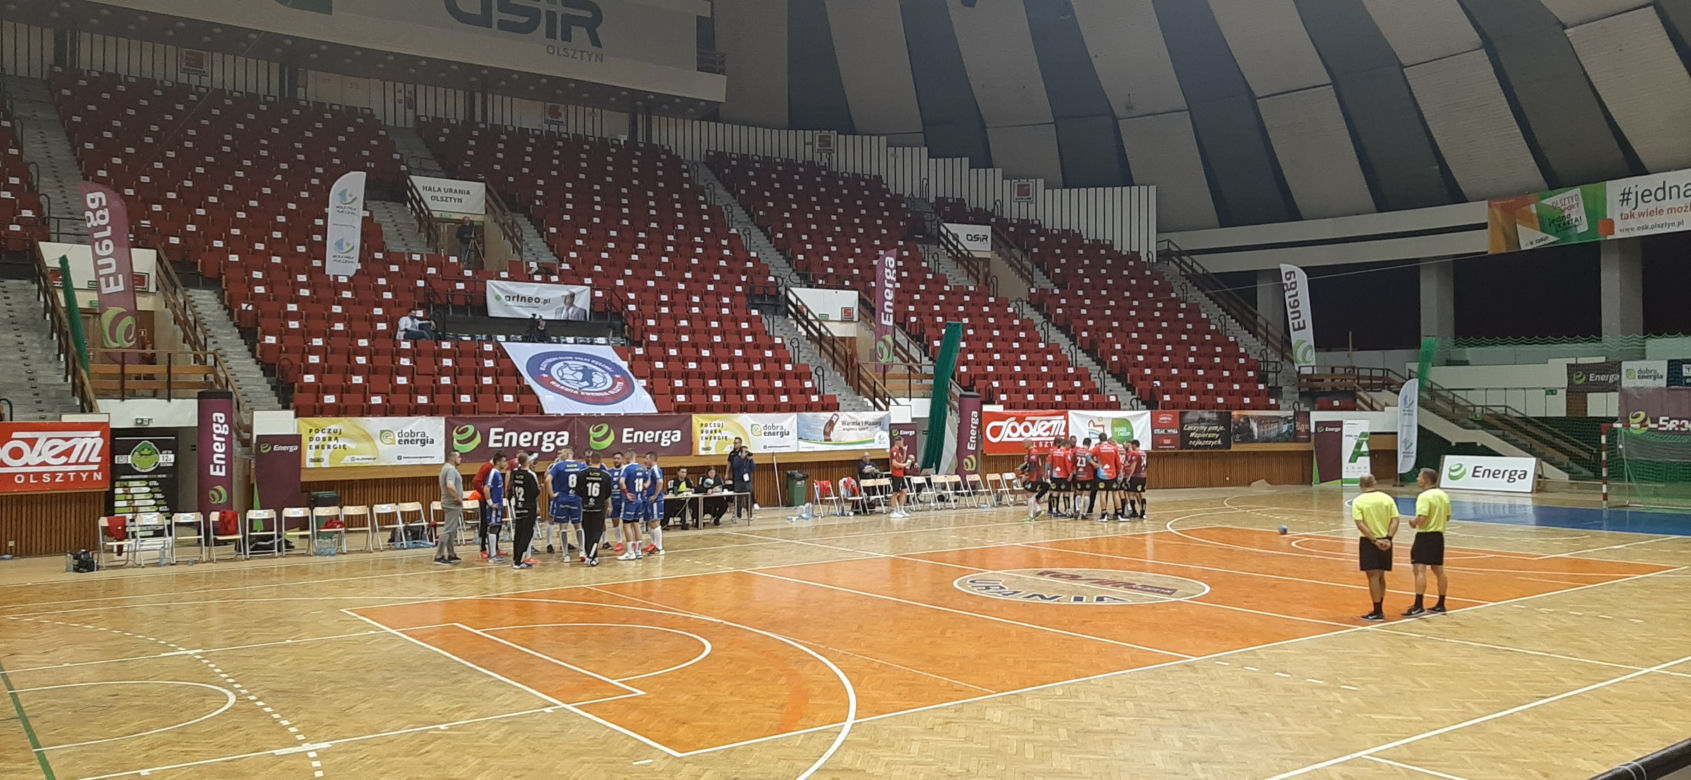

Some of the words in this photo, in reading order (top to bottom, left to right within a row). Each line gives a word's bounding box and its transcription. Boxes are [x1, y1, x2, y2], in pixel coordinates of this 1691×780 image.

[545, 44, 604, 64] OLSZTYN
[422, 184, 443, 193] HALA
[443, 187, 471, 196] URANIA
[430, 195, 463, 204] OLSZTYN
[1619, 210, 1635, 221] tak
[1637, 205, 1665, 219] wiele
[881, 255, 897, 326] Energa
[504, 293, 551, 305] artneo.pl
[1588, 372, 1620, 384] Energa
[308, 428, 343, 436] POCZUJ
[397, 428, 426, 439] dobra
[762, 423, 784, 431] dobra
[967, 410, 979, 451] Energa
[488, 427, 570, 452] Energa
[621, 426, 682, 445] Energa
[763, 429, 790, 439] energia
[210, 411, 229, 477] Energa
[273, 443, 298, 454] Energa
[398, 436, 435, 448] energia
[1076, 457, 1086, 467] 23
[14, 471, 103, 484] OLSZTYN
[568, 473, 577, 488] 8
[1471, 465, 1528, 484] Energa
[515, 486, 525, 502] 12
[586, 482, 601, 498] 16
